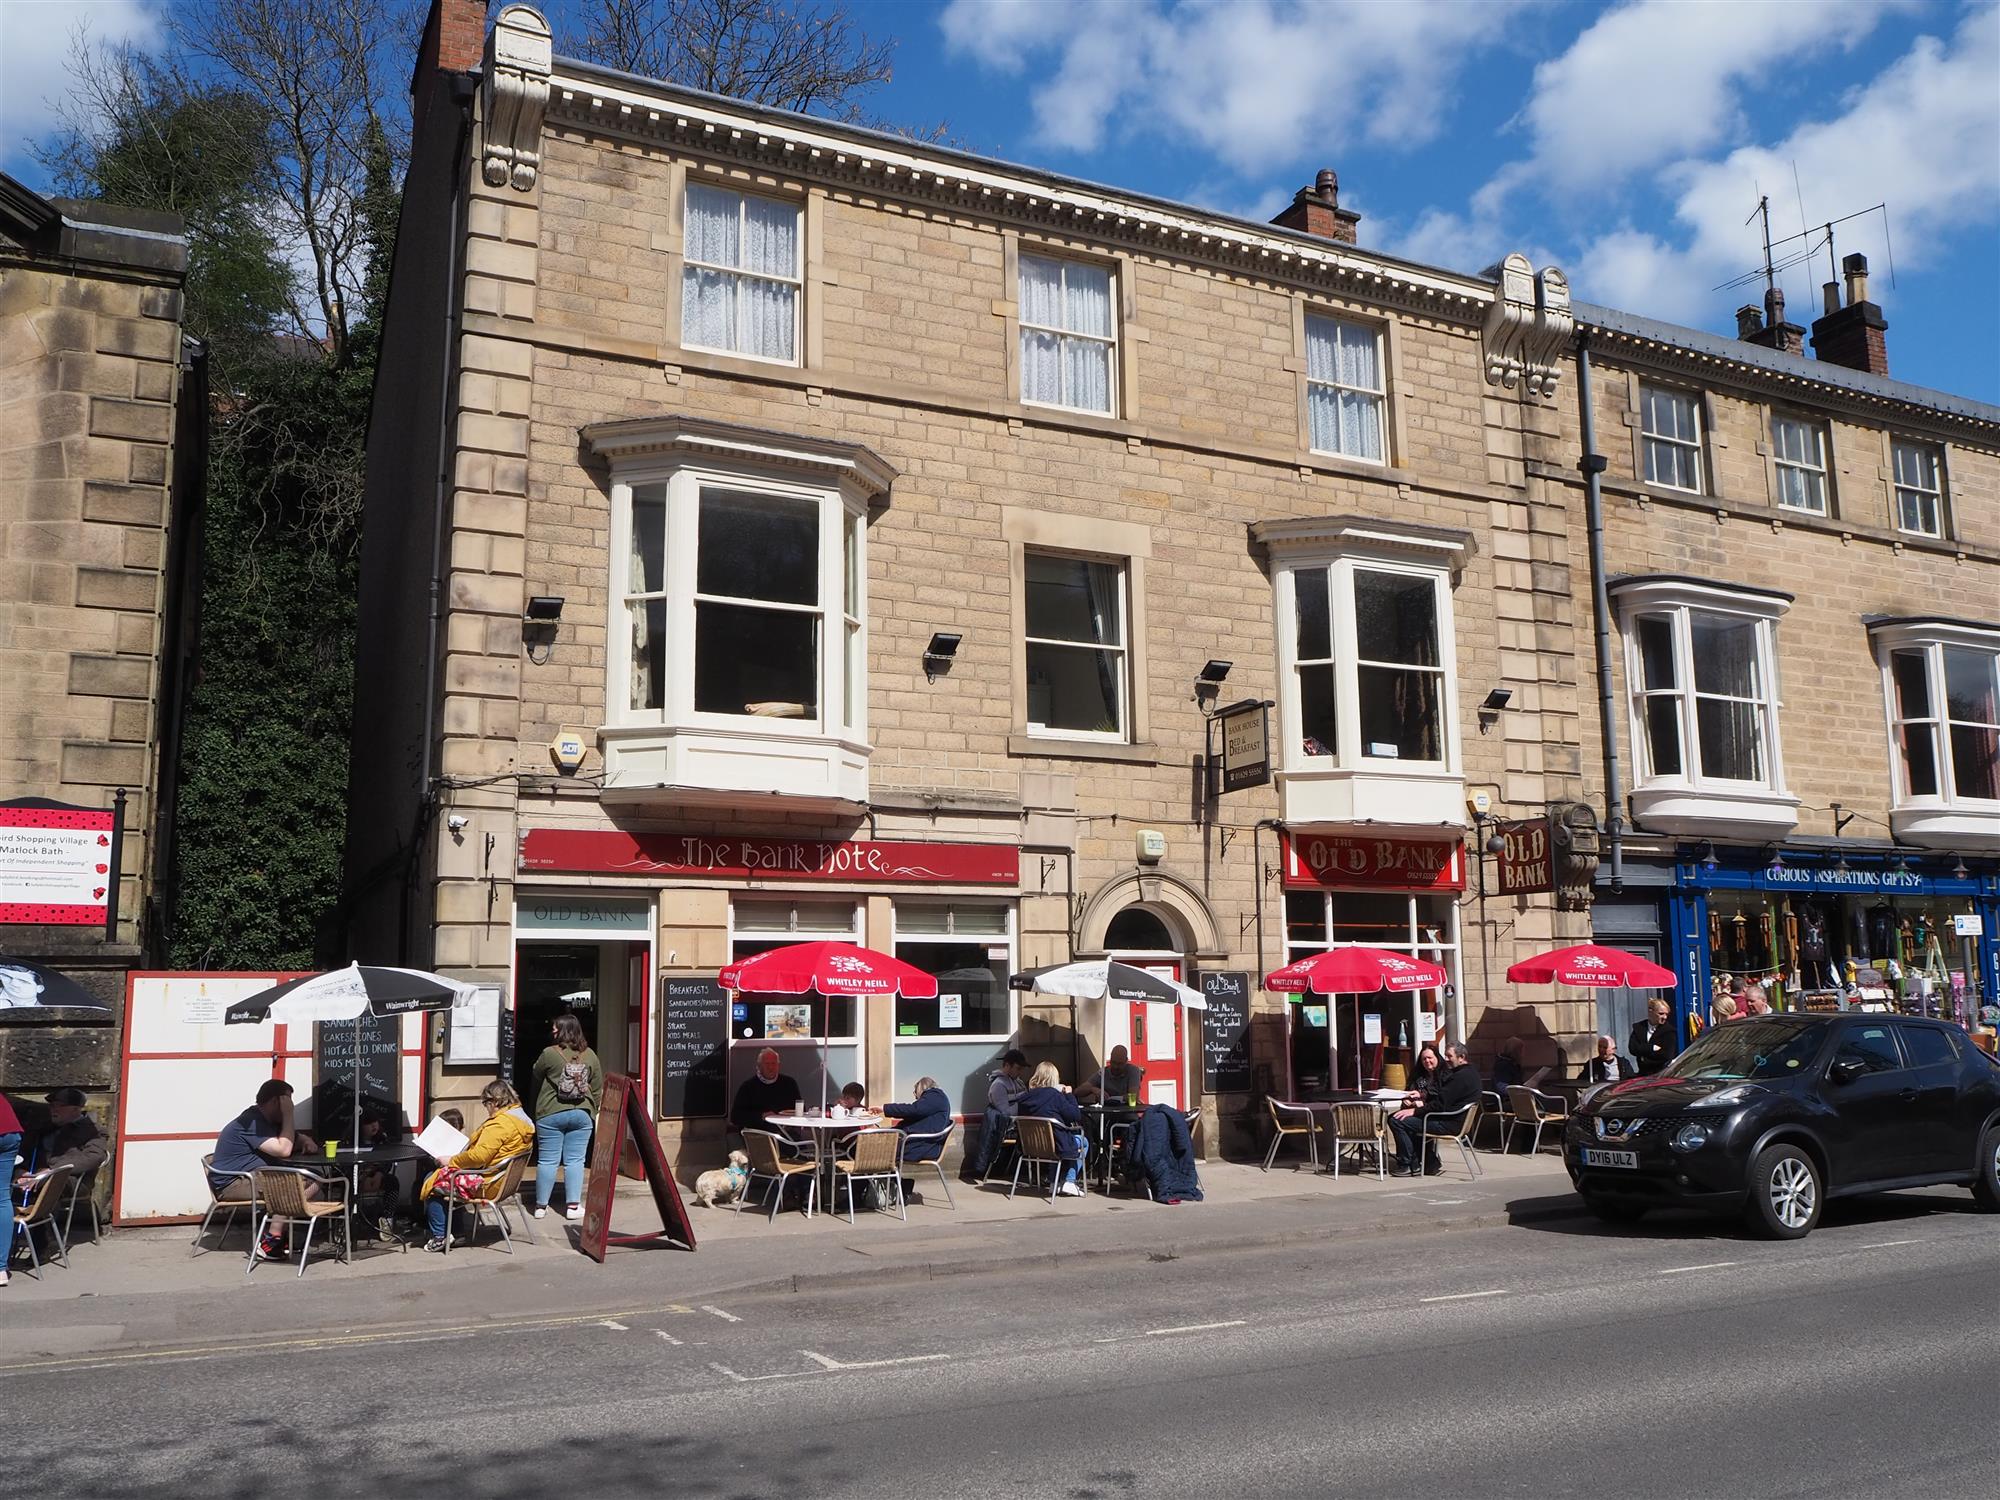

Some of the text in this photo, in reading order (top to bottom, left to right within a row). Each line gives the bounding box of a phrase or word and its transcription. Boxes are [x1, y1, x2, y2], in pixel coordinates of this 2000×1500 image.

[1228, 719, 1260, 735] BANK HOUSE
[0, 834, 89, 846] ird Shopping Village
[1333, 838, 1353, 847] THE
[1503, 828, 1545, 862] OLD
[0, 846, 38, 855] Matlock
[41, 847, 64, 855] Bath
[682, 837, 731, 871] The
[741, 841, 814, 874] Bank
[1309, 840, 1446, 873] OLD BANK
[1504, 861, 1547, 888] BANK
[1766, 867, 1810, 882] CURIOUS
[534, 905, 632, 922] OLD BANK
[1391, 974, 1433, 984] WHITLEY NEILL
[1565, 972, 1617, 981] WHITLEY NEILL
[827, 977, 888, 988] WHITLEY NEILL
[669, 984, 709, 994] BREAKFASTS
[385, 999, 420, 1009] Wainwright
[684, 1010, 698, 1018] COLD
[324, 1045, 341, 1056] HOT
[324, 1059, 342, 1068] KIDS
[1589, 1150, 1633, 1166] DY16 ULZ
